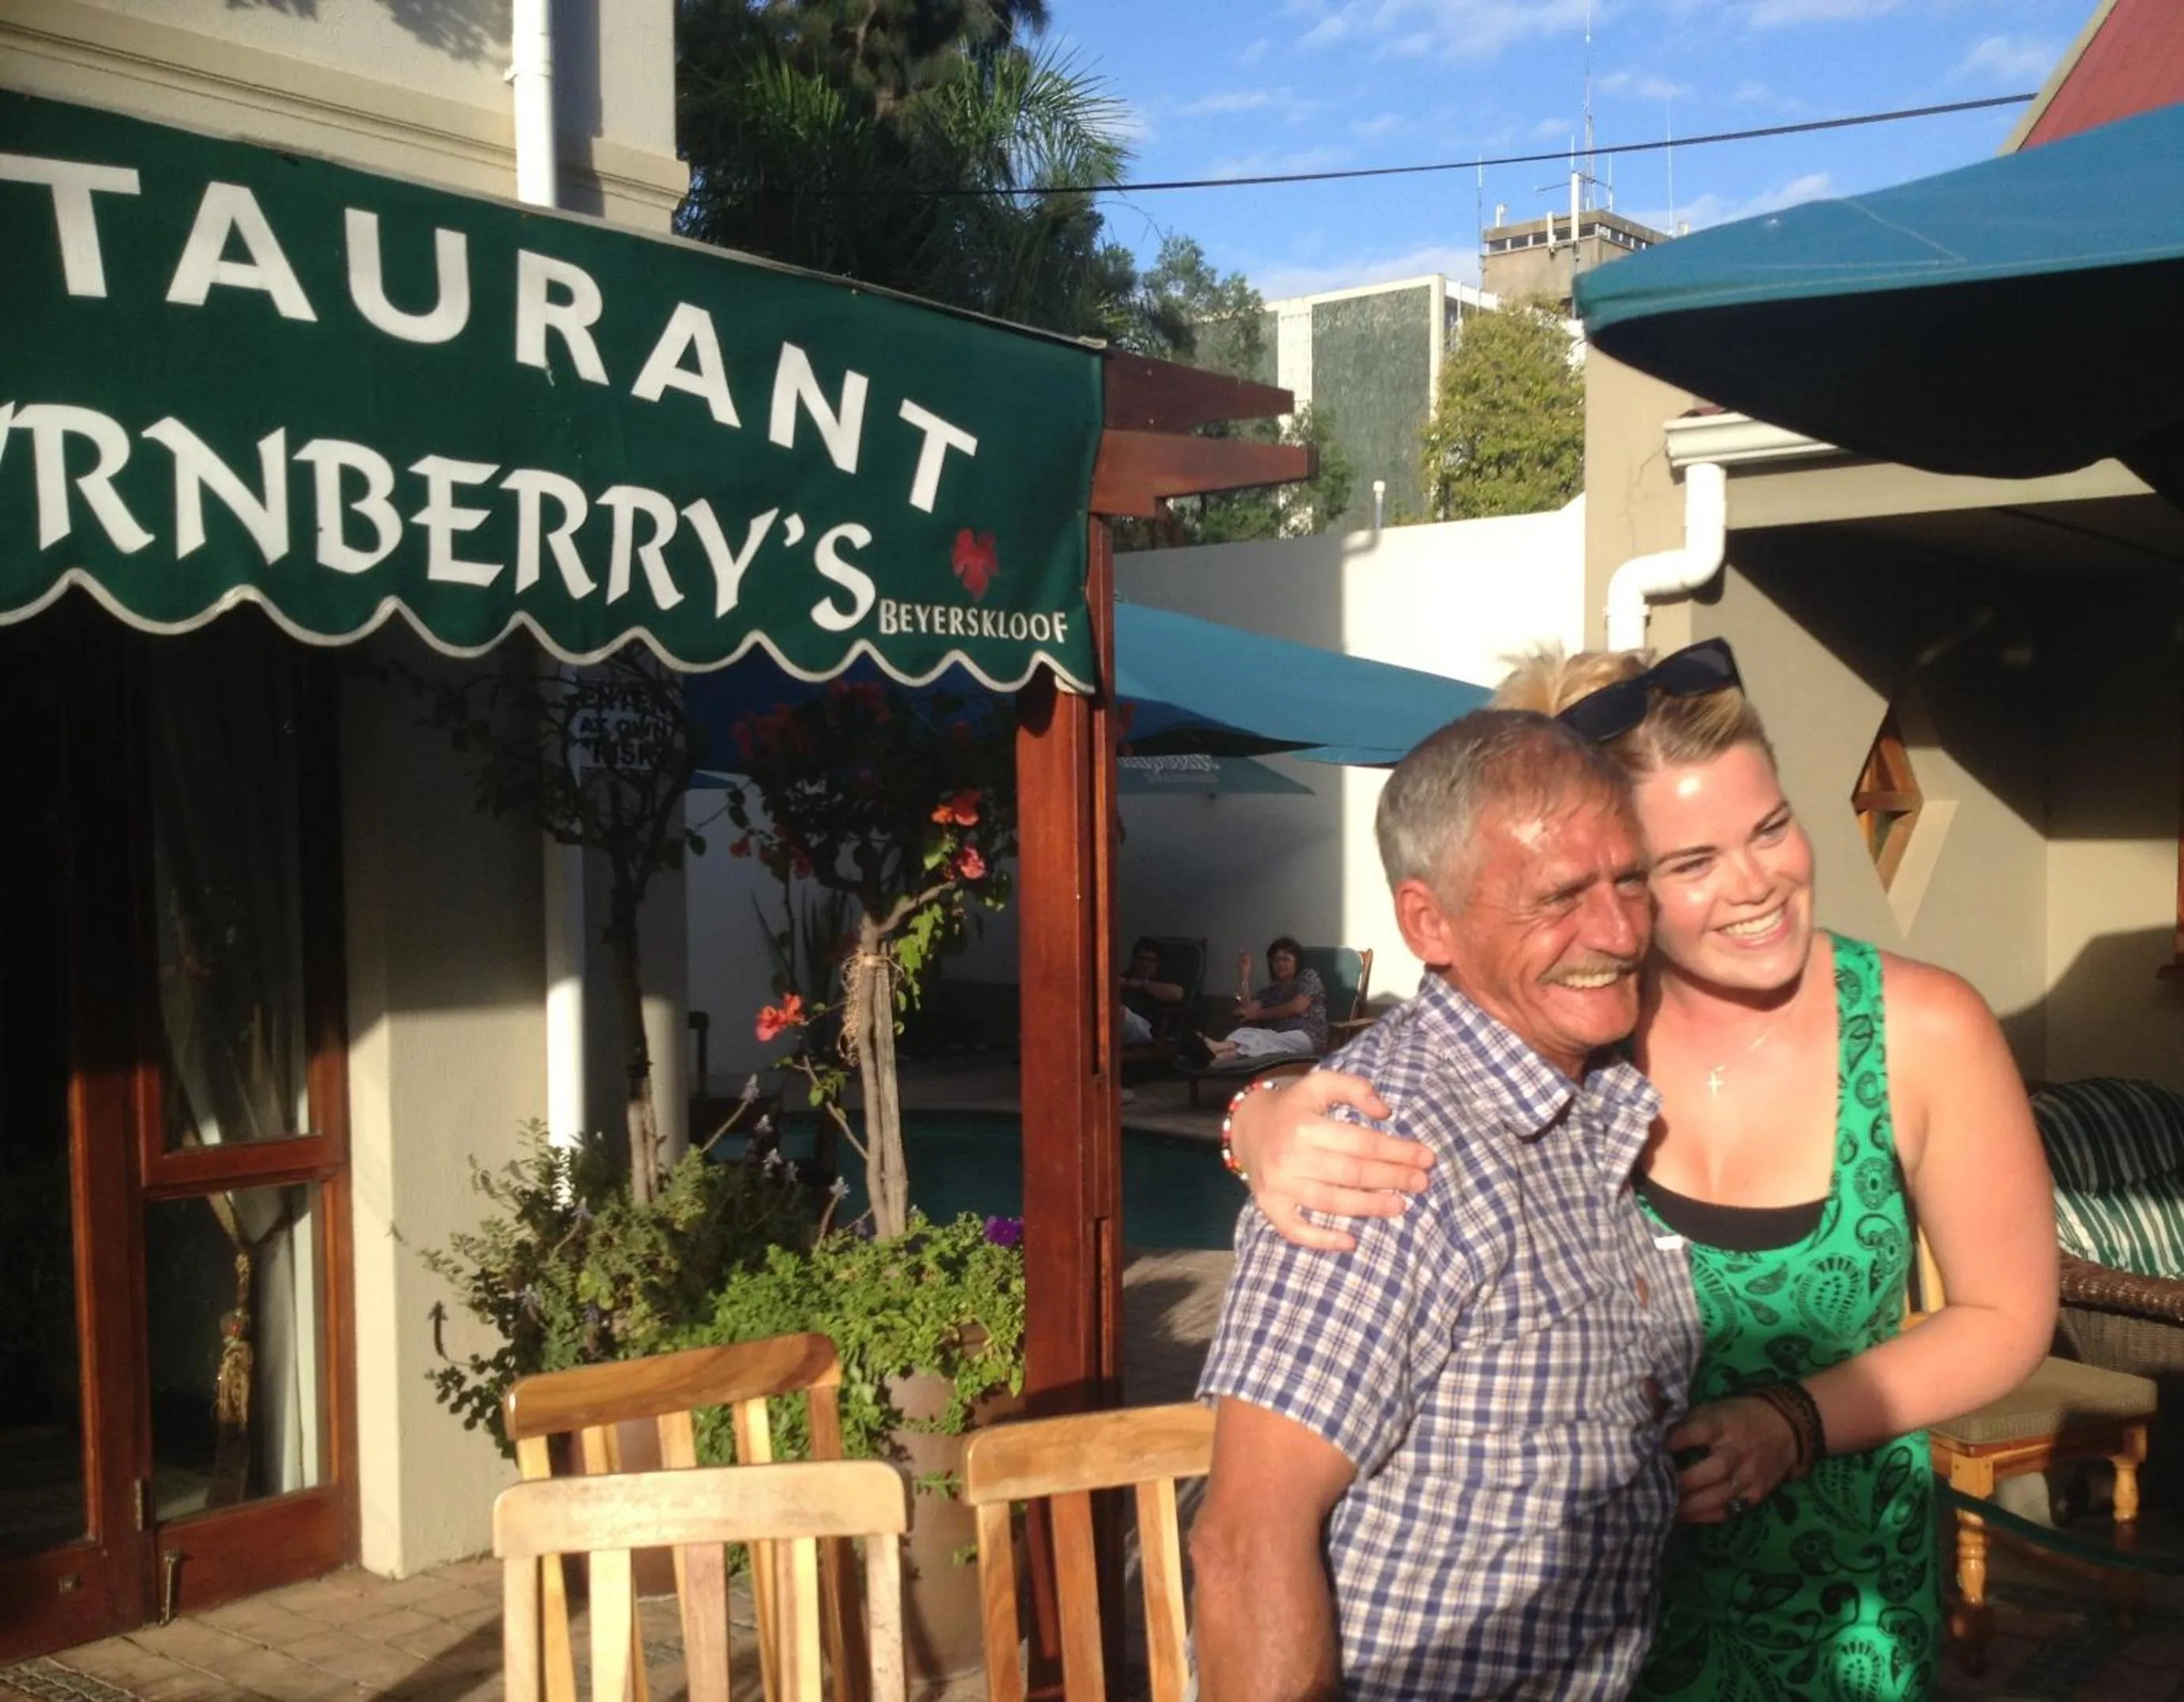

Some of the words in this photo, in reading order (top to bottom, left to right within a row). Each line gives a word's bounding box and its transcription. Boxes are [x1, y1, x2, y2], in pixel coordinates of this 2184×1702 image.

[0, 154, 977, 514] TAURANT
[0, 400, 875, 632] RNBERRY'S
[879, 599, 1068, 643] BEYERSKLOOF
